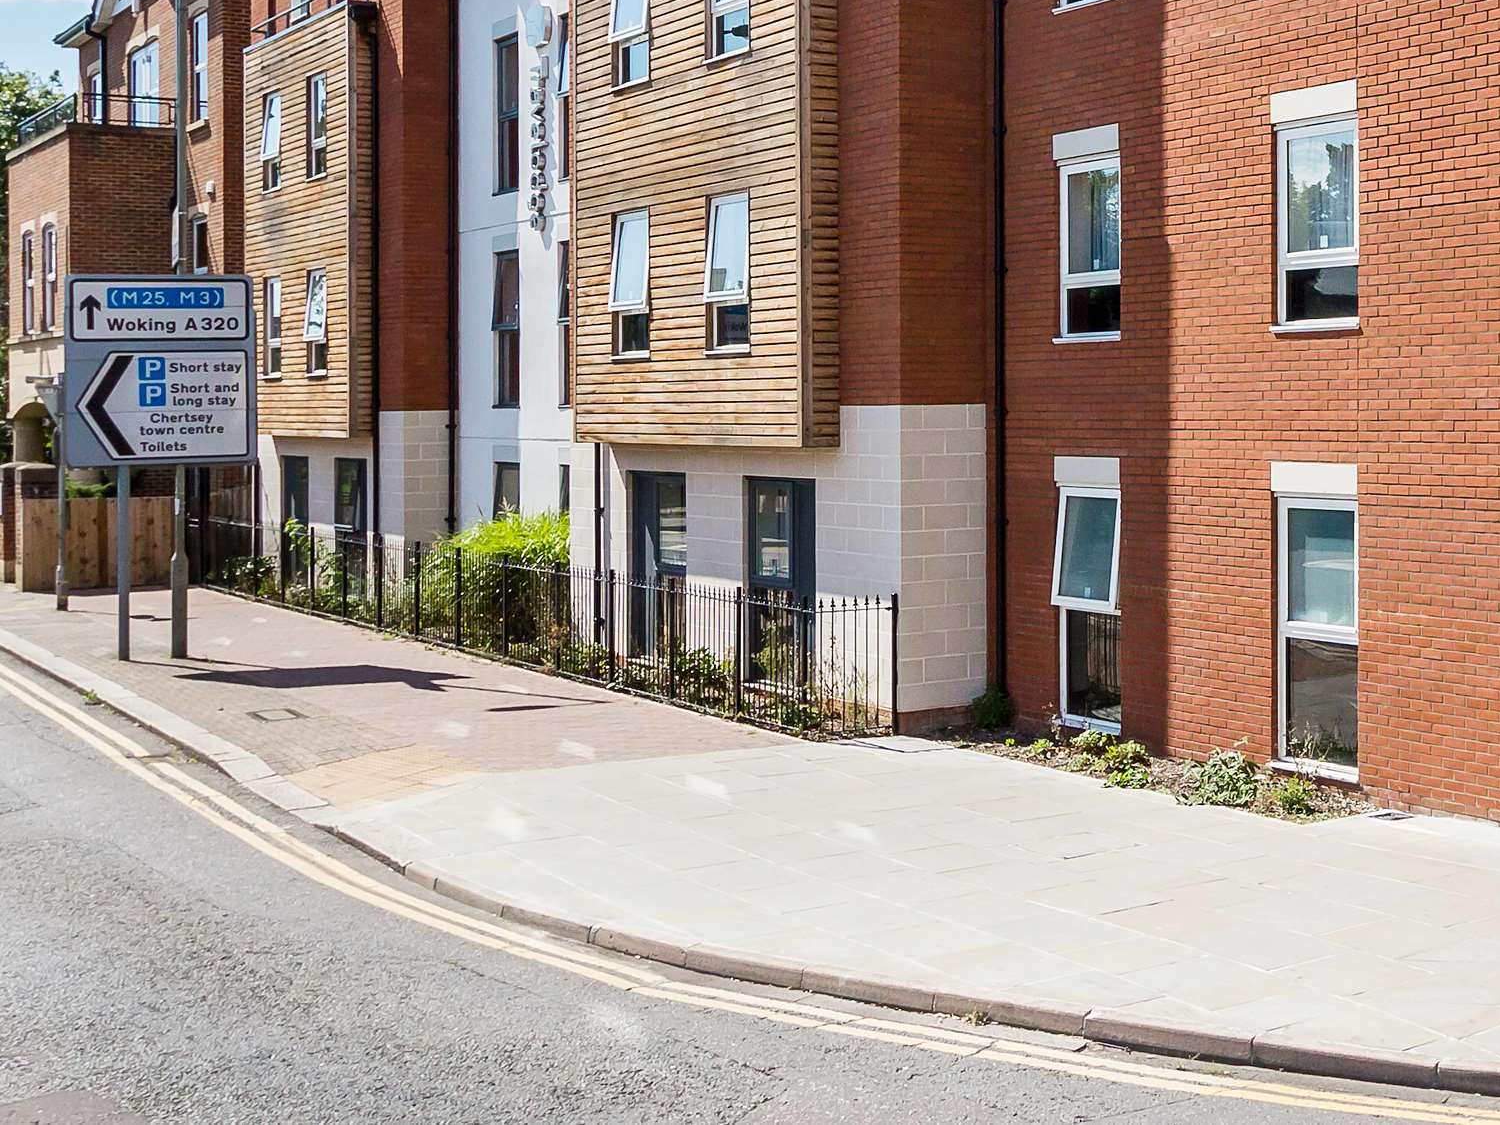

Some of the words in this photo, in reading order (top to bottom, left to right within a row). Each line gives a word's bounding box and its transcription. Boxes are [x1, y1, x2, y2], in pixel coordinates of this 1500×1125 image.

[180, 290, 221, 306] M3)
[107, 318, 176, 334] Woking
[184, 317, 240, 331] A320
[144, 359, 161, 378] P
[169, 362, 209, 373] Short
[213, 362, 242, 373] stay
[145, 385, 162, 404] P
[170, 383, 210, 393] Short
[215, 382, 240, 393] and
[173, 396, 203, 407] long
[207, 395, 237, 407] stay
[150, 413, 213, 423] Chertsey
[140, 426, 175, 436] town
[179, 425, 225, 435] centre
[140, 441, 188, 452] Toilets
